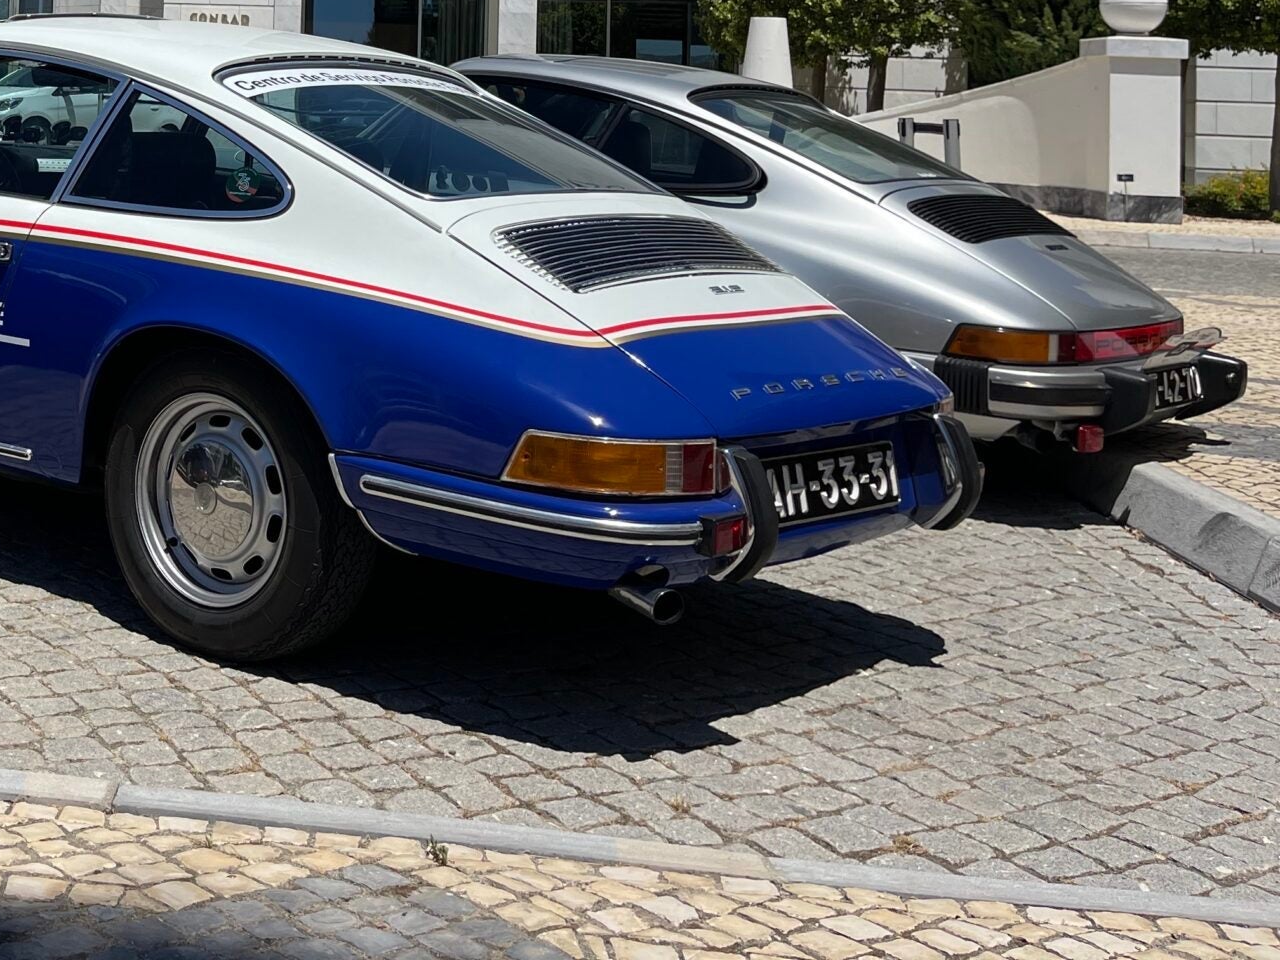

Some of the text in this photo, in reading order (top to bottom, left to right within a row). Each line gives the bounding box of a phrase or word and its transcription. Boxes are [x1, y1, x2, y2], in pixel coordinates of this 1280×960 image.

[189, 12, 250, 27] CONRAD
[234, 76, 302, 91] Centro
[300, 73, 325, 83] de
[730, 367, 909, 401] PORSCHE
